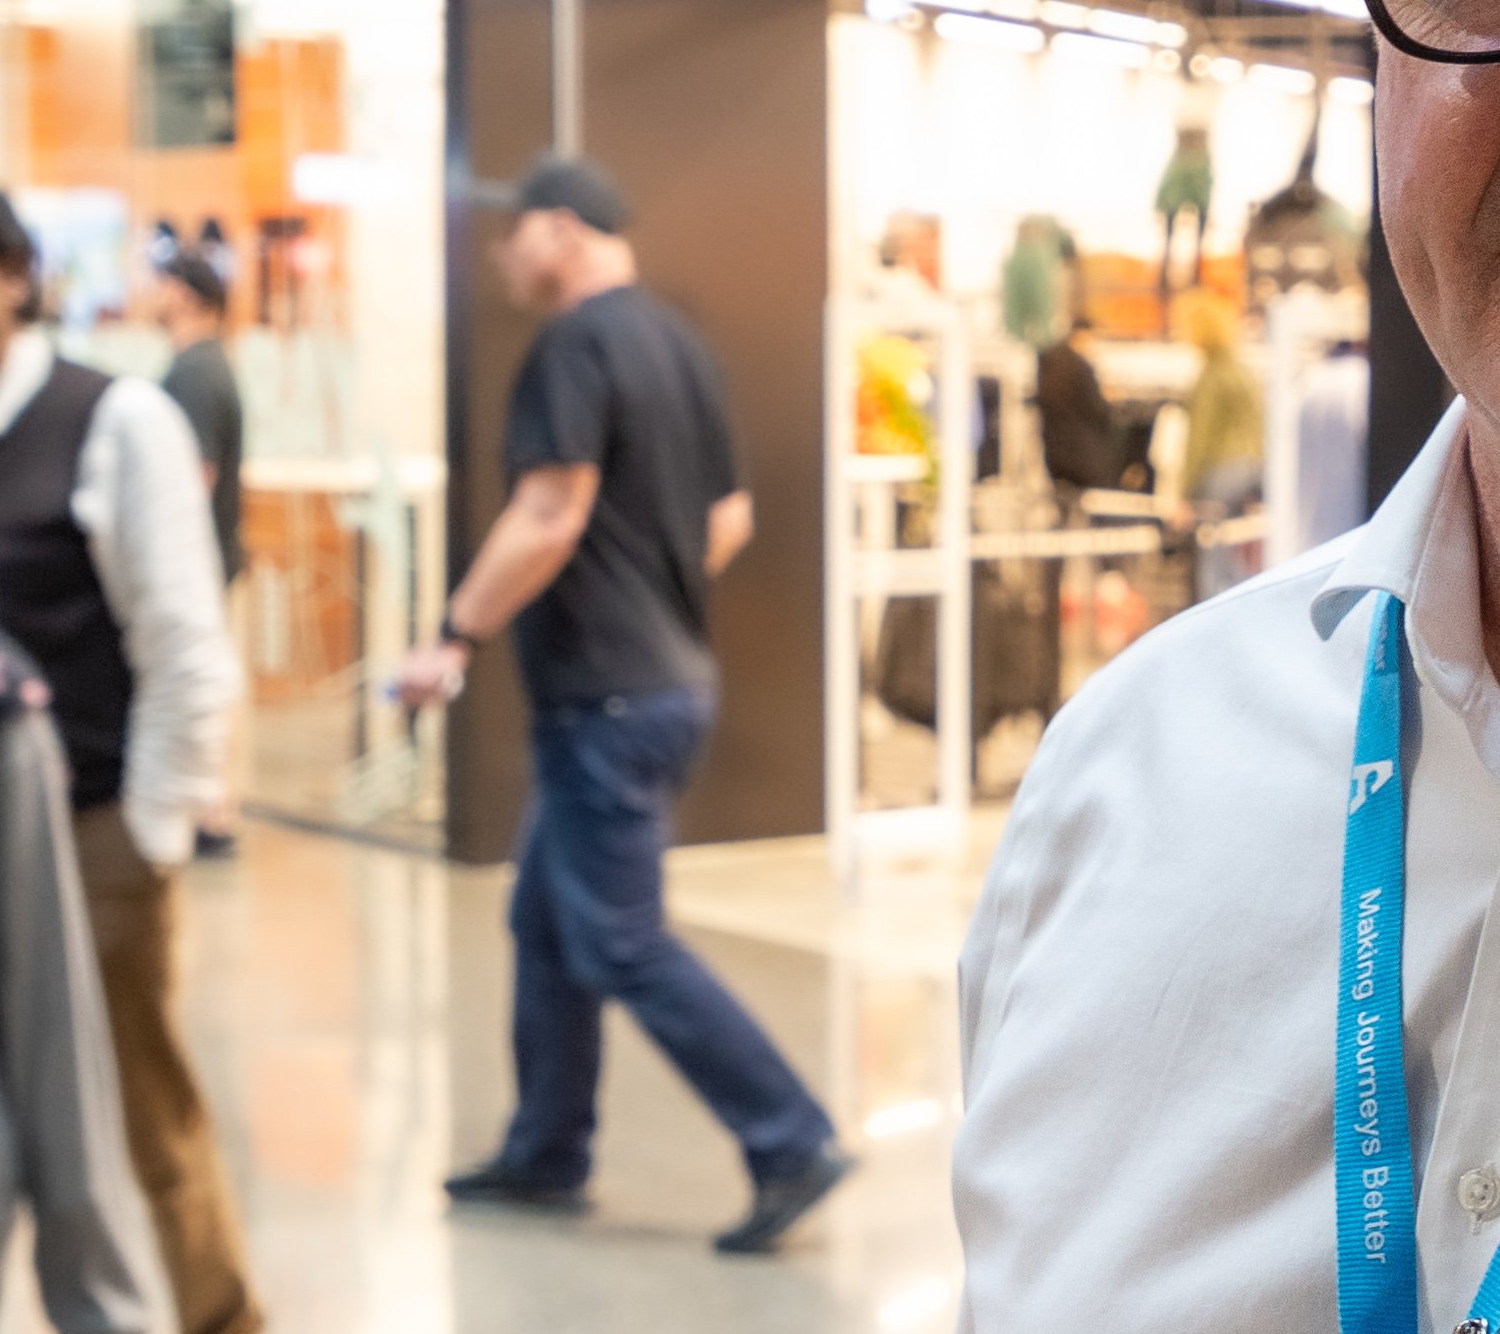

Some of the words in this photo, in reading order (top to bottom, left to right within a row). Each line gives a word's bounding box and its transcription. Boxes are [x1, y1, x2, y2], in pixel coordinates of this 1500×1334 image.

[1352, 887, 1382, 1001] Making
[1354, 1011, 1382, 1156] Journeys
[1362, 1166, 1389, 1263] Better
